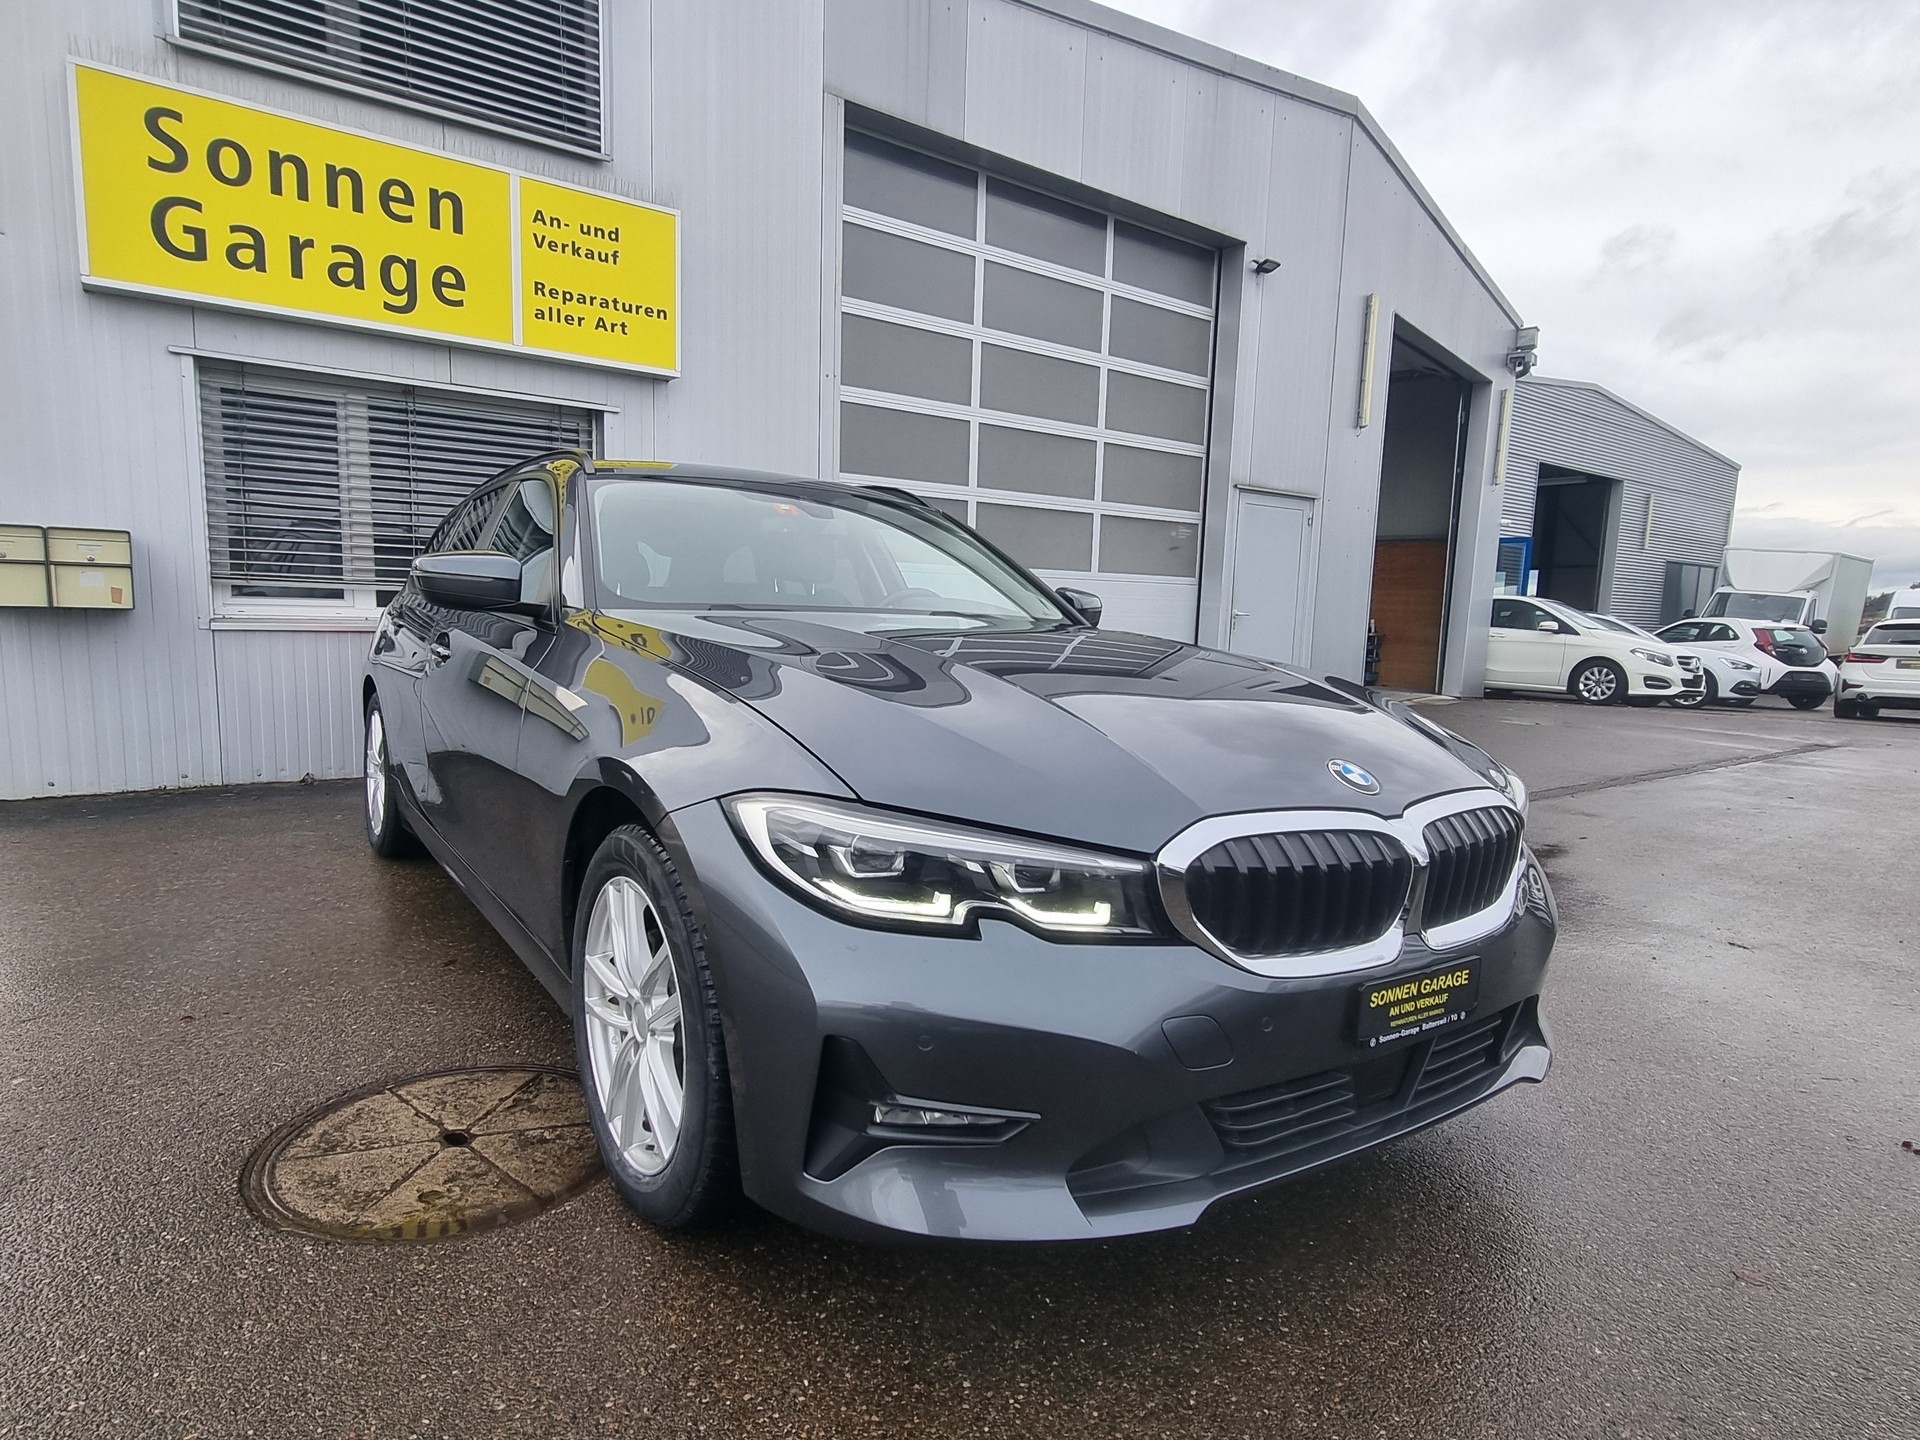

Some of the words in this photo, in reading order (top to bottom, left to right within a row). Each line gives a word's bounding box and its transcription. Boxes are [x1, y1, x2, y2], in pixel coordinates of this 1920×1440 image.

[143, 106, 464, 236] Sonnen
[532, 209, 570, 230] An-
[579, 223, 620, 243] und
[150, 196, 466, 315] Garage
[532, 232, 620, 266] Verkauf
[533, 280, 668, 321] Reparaturen
[534, 306, 586, 328] aller
[594, 316, 628, 336] Art
[1370, 982, 1418, 1008] SONNEN
[1420, 969, 1470, 994] GARAGE
[1388, 1006, 1400, 1017] AN
[1400, 1001, 1415, 1014] UND
[1416, 993, 1449, 1011] VERKAUF
[1378, 1026, 1420, 1044] Sonnen-Garage
